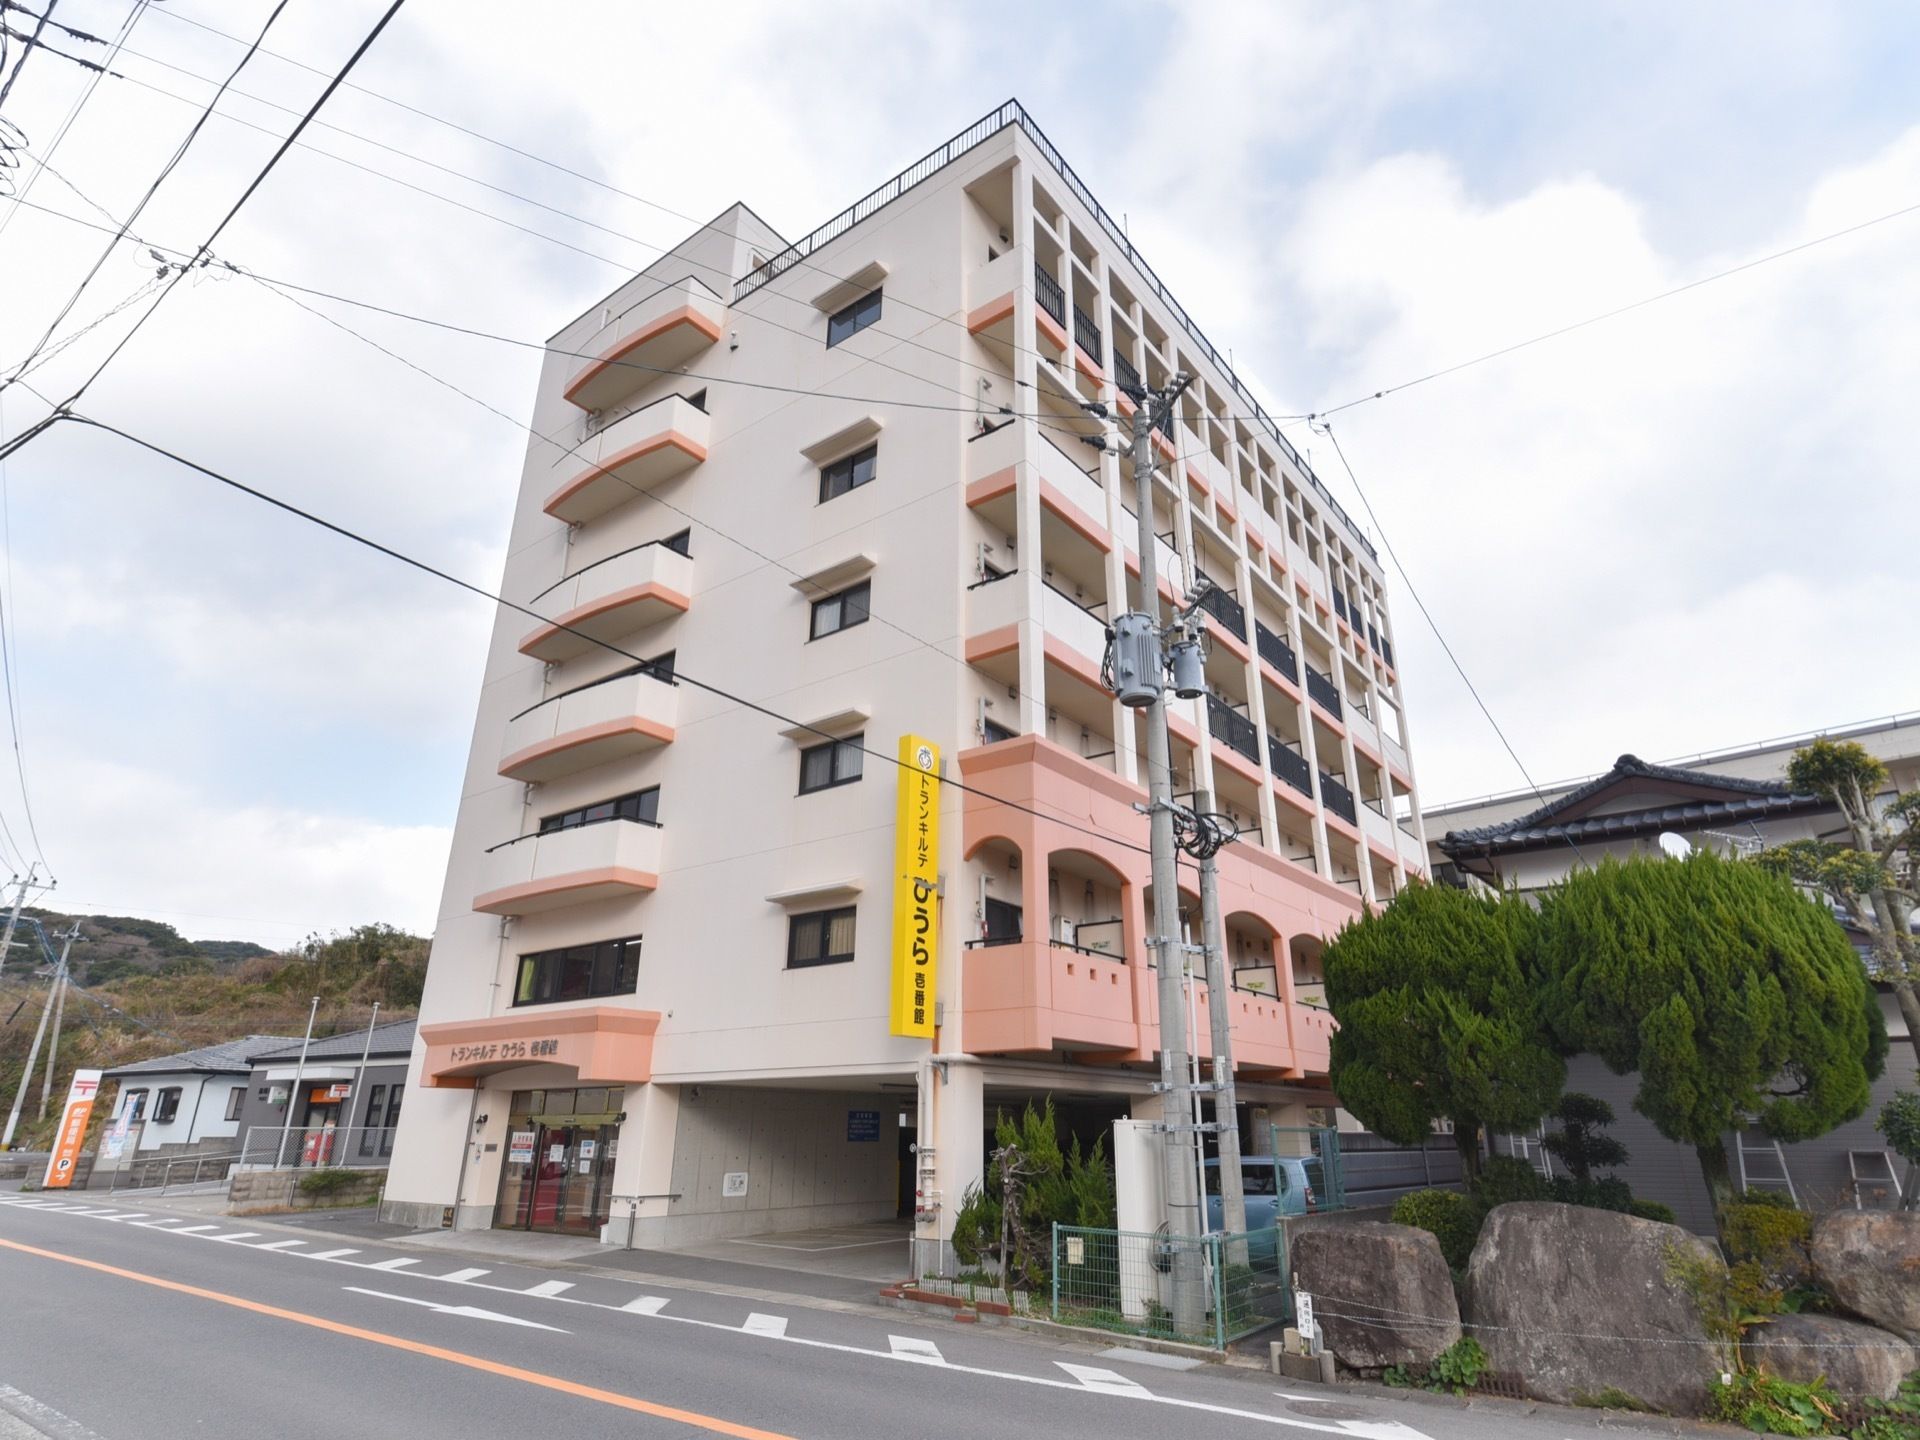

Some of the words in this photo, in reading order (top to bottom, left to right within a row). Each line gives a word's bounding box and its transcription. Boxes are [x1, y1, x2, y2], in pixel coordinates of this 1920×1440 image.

[917, 775, 930, 868] トランキルテ
[912, 876, 931, 966] ひうら
[914, 972, 926, 1025] 壱番館
[451, 1045, 497, 1062] トランキルテ
[501, 1042, 525, 1058] ひうら
[60, 1159, 69, 1170] P
